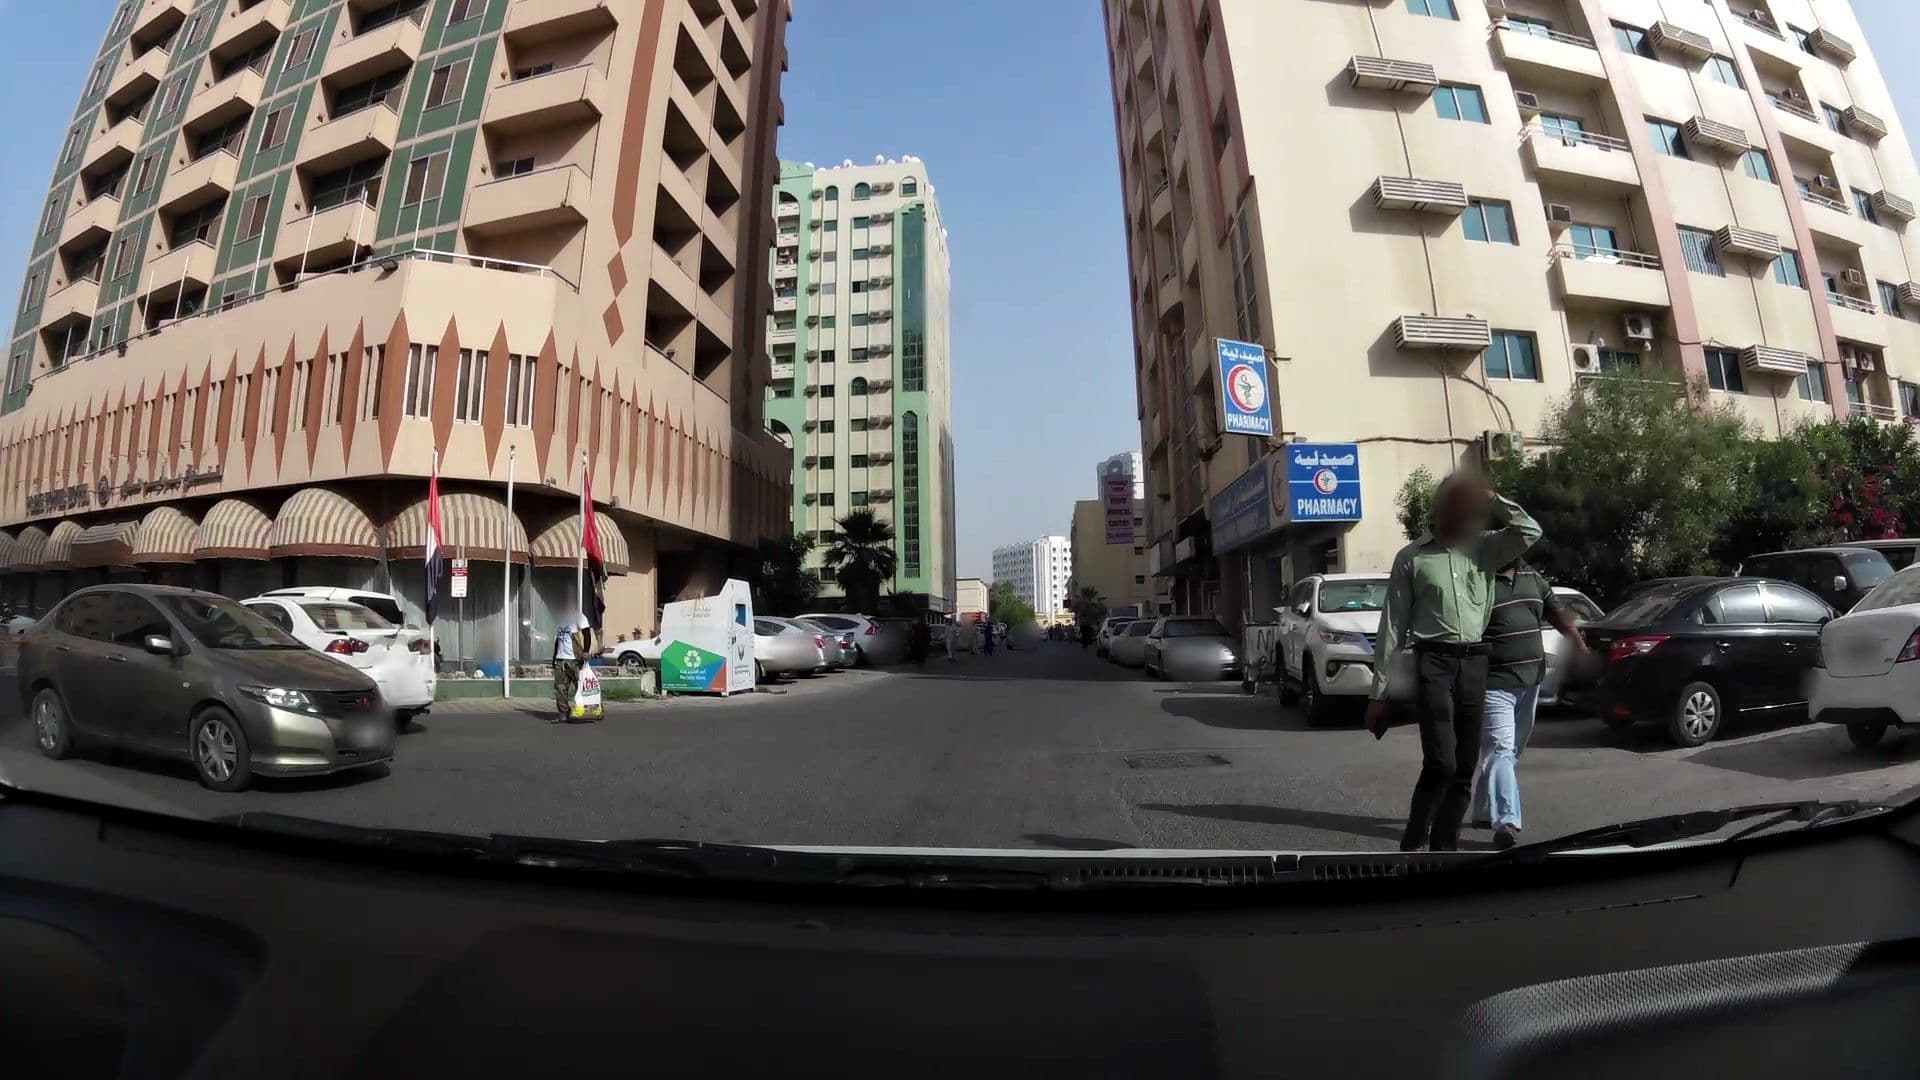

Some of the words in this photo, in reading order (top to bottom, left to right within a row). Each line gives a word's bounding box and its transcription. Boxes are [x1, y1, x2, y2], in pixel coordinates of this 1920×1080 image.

[1220, 343, 1264, 364] صيدلية
[1227, 413, 1269, 430] PHARMACY
[1294, 449, 1355, 469] صيدلية
[1297, 498, 1357, 515] PHARMACY
